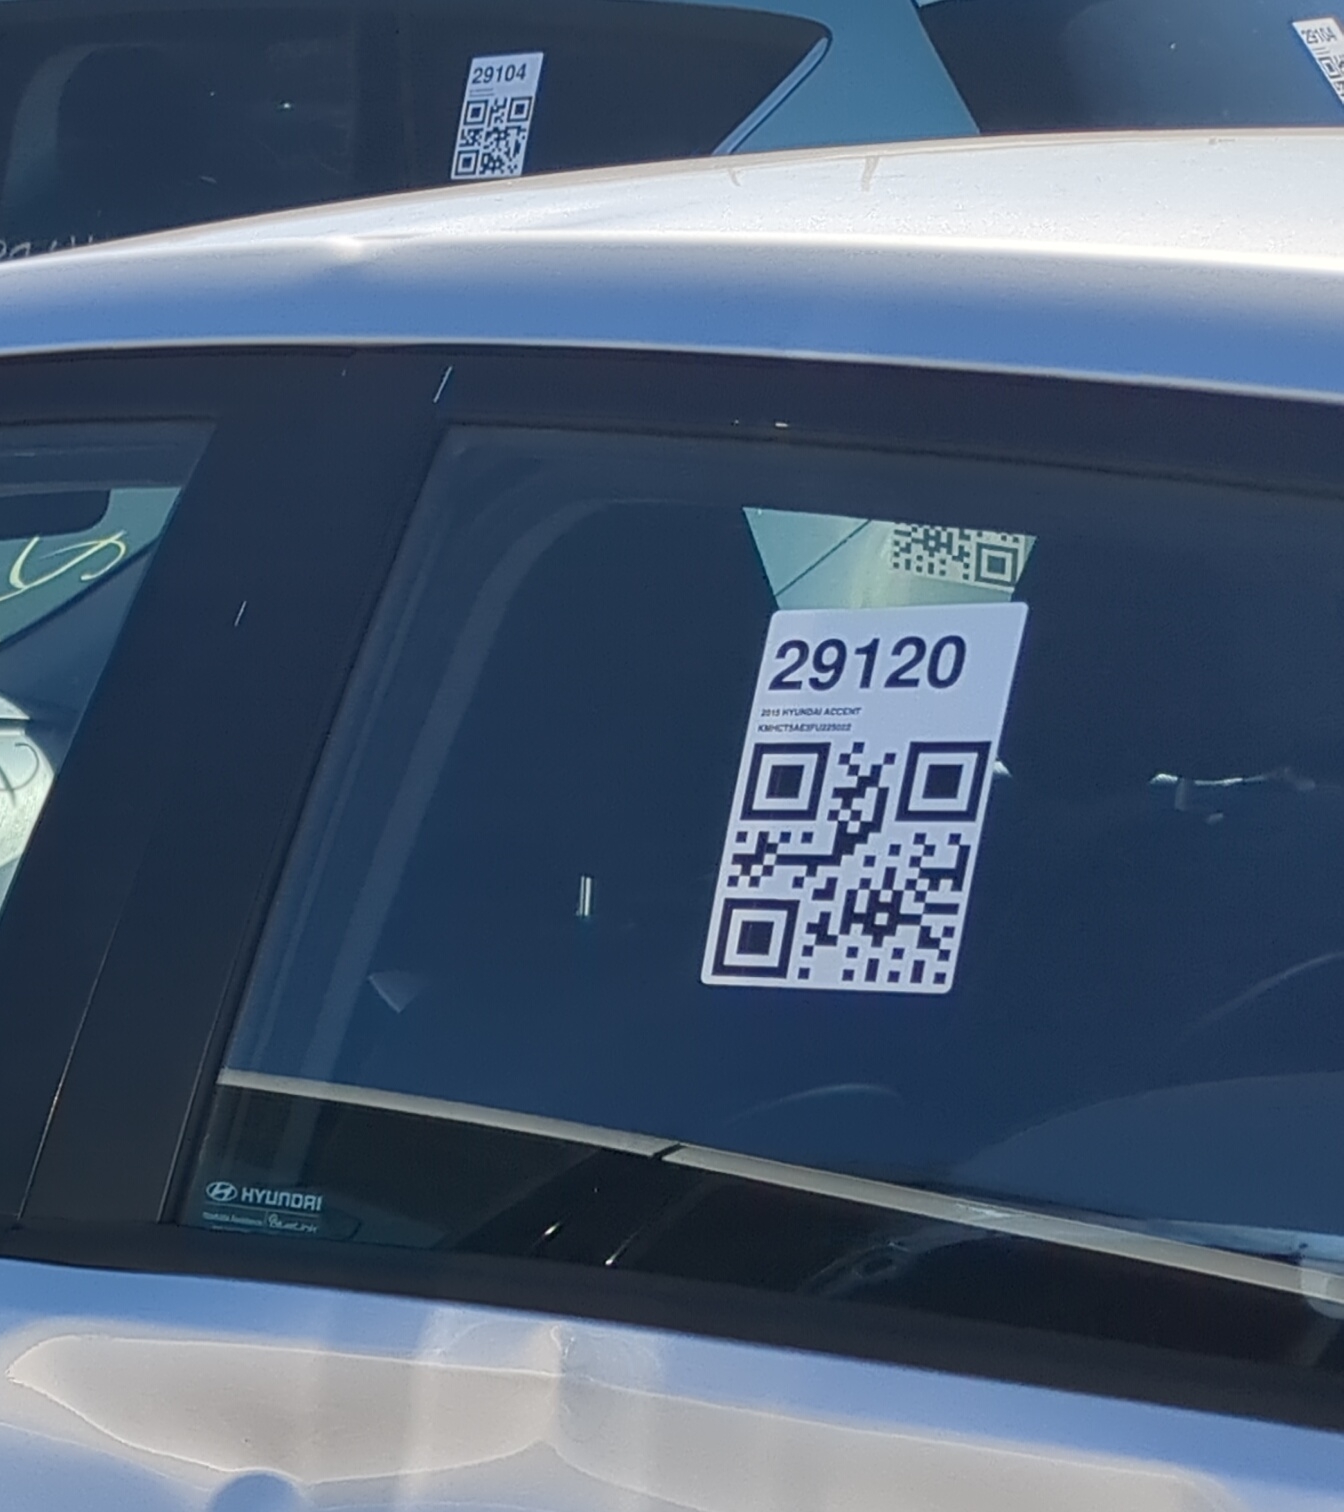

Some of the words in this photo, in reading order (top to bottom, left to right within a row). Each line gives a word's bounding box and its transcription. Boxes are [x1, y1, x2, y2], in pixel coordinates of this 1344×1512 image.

[472, 63, 527, 84] 29104
[768, 635, 967, 691] 29120
[782, 707, 823, 716] HYUNDAI
[823, 707, 862, 716] ACCENT
[241, 1187, 323, 1211] HYUNDAI
